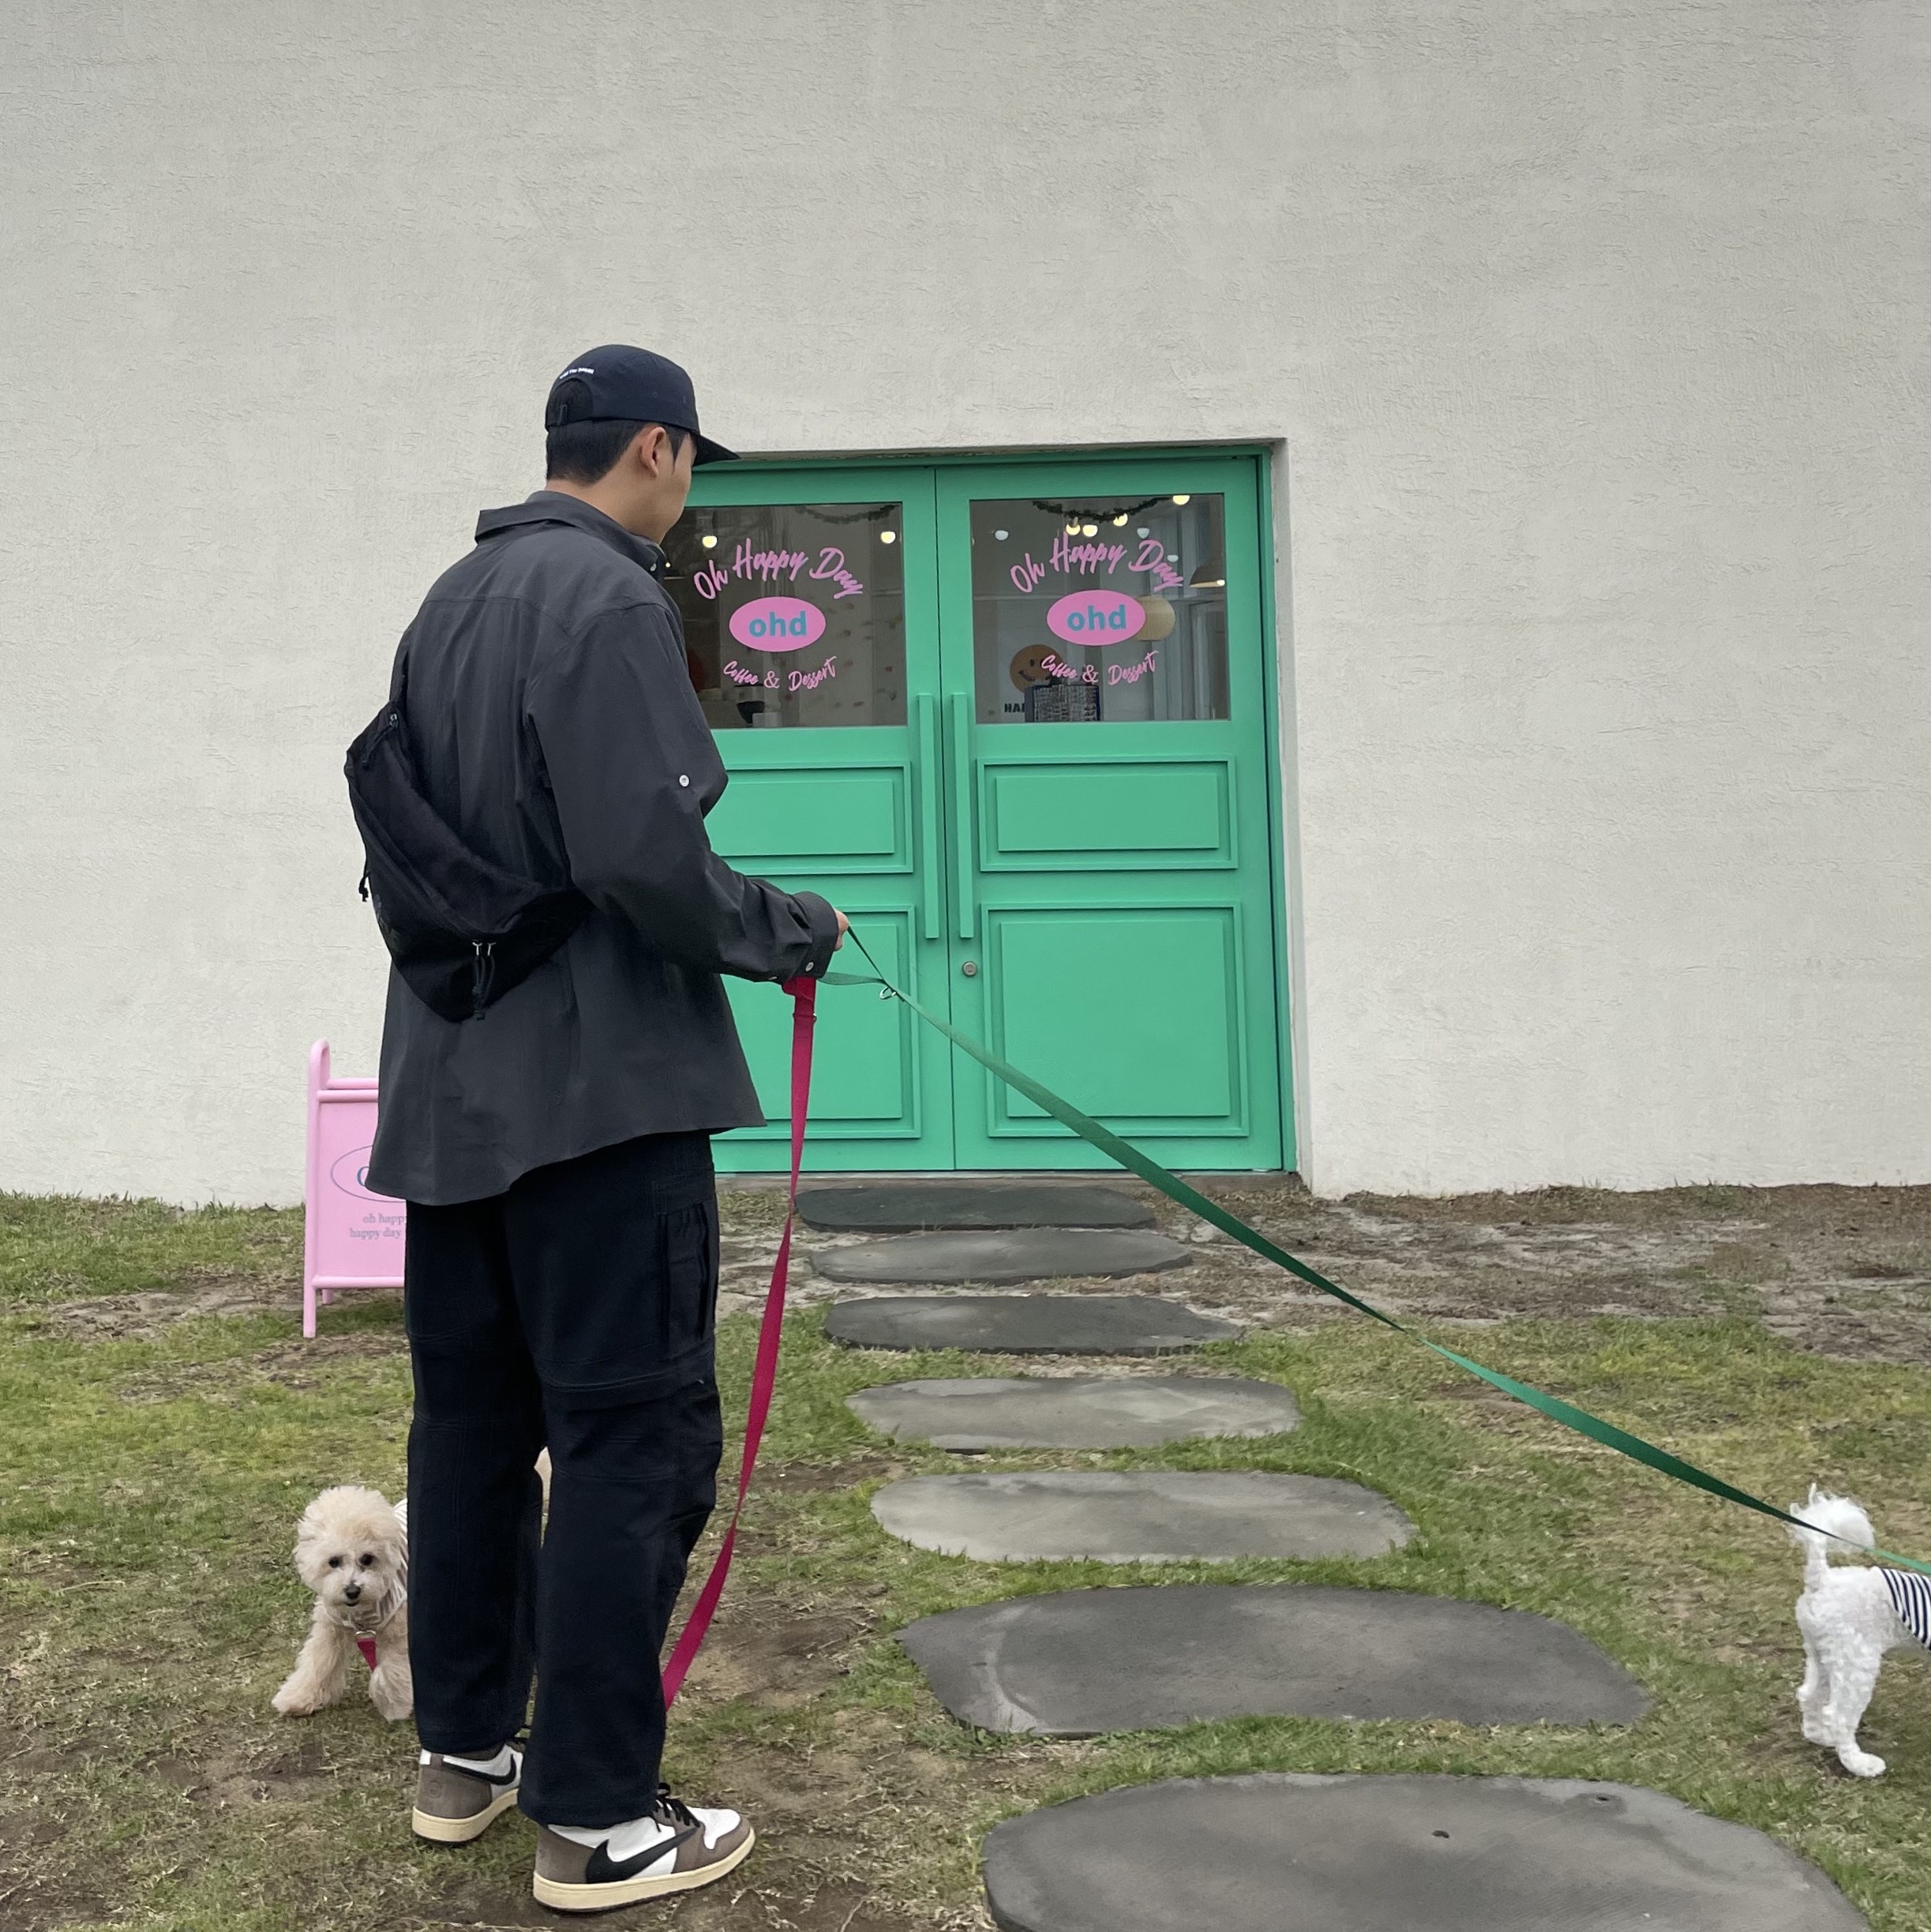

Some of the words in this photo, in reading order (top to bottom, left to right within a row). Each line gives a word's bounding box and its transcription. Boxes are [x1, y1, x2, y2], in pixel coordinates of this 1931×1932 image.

[693, 560, 729, 600] Oh
[733, 538, 808, 582] Happy
[809, 547, 864, 599] Day
[1010, 553, 1046, 593] Oh
[1049, 531, 1127, 575] Happy
[1128, 539, 1184, 592] Day
[748, 610, 808, 638] ohd
[1067, 604, 1127, 632] ohd
[723, 660, 759, 685] Coffee
[763, 670, 780, 689] &
[788, 655, 838, 692] Dessert
[1040, 654, 1078, 679] Coffee
[1082, 664, 1099, 685] &
[1108, 650, 1160, 685] Dessert
[350, 1228, 380, 1240] happy
[383, 1227, 402, 1240] day
